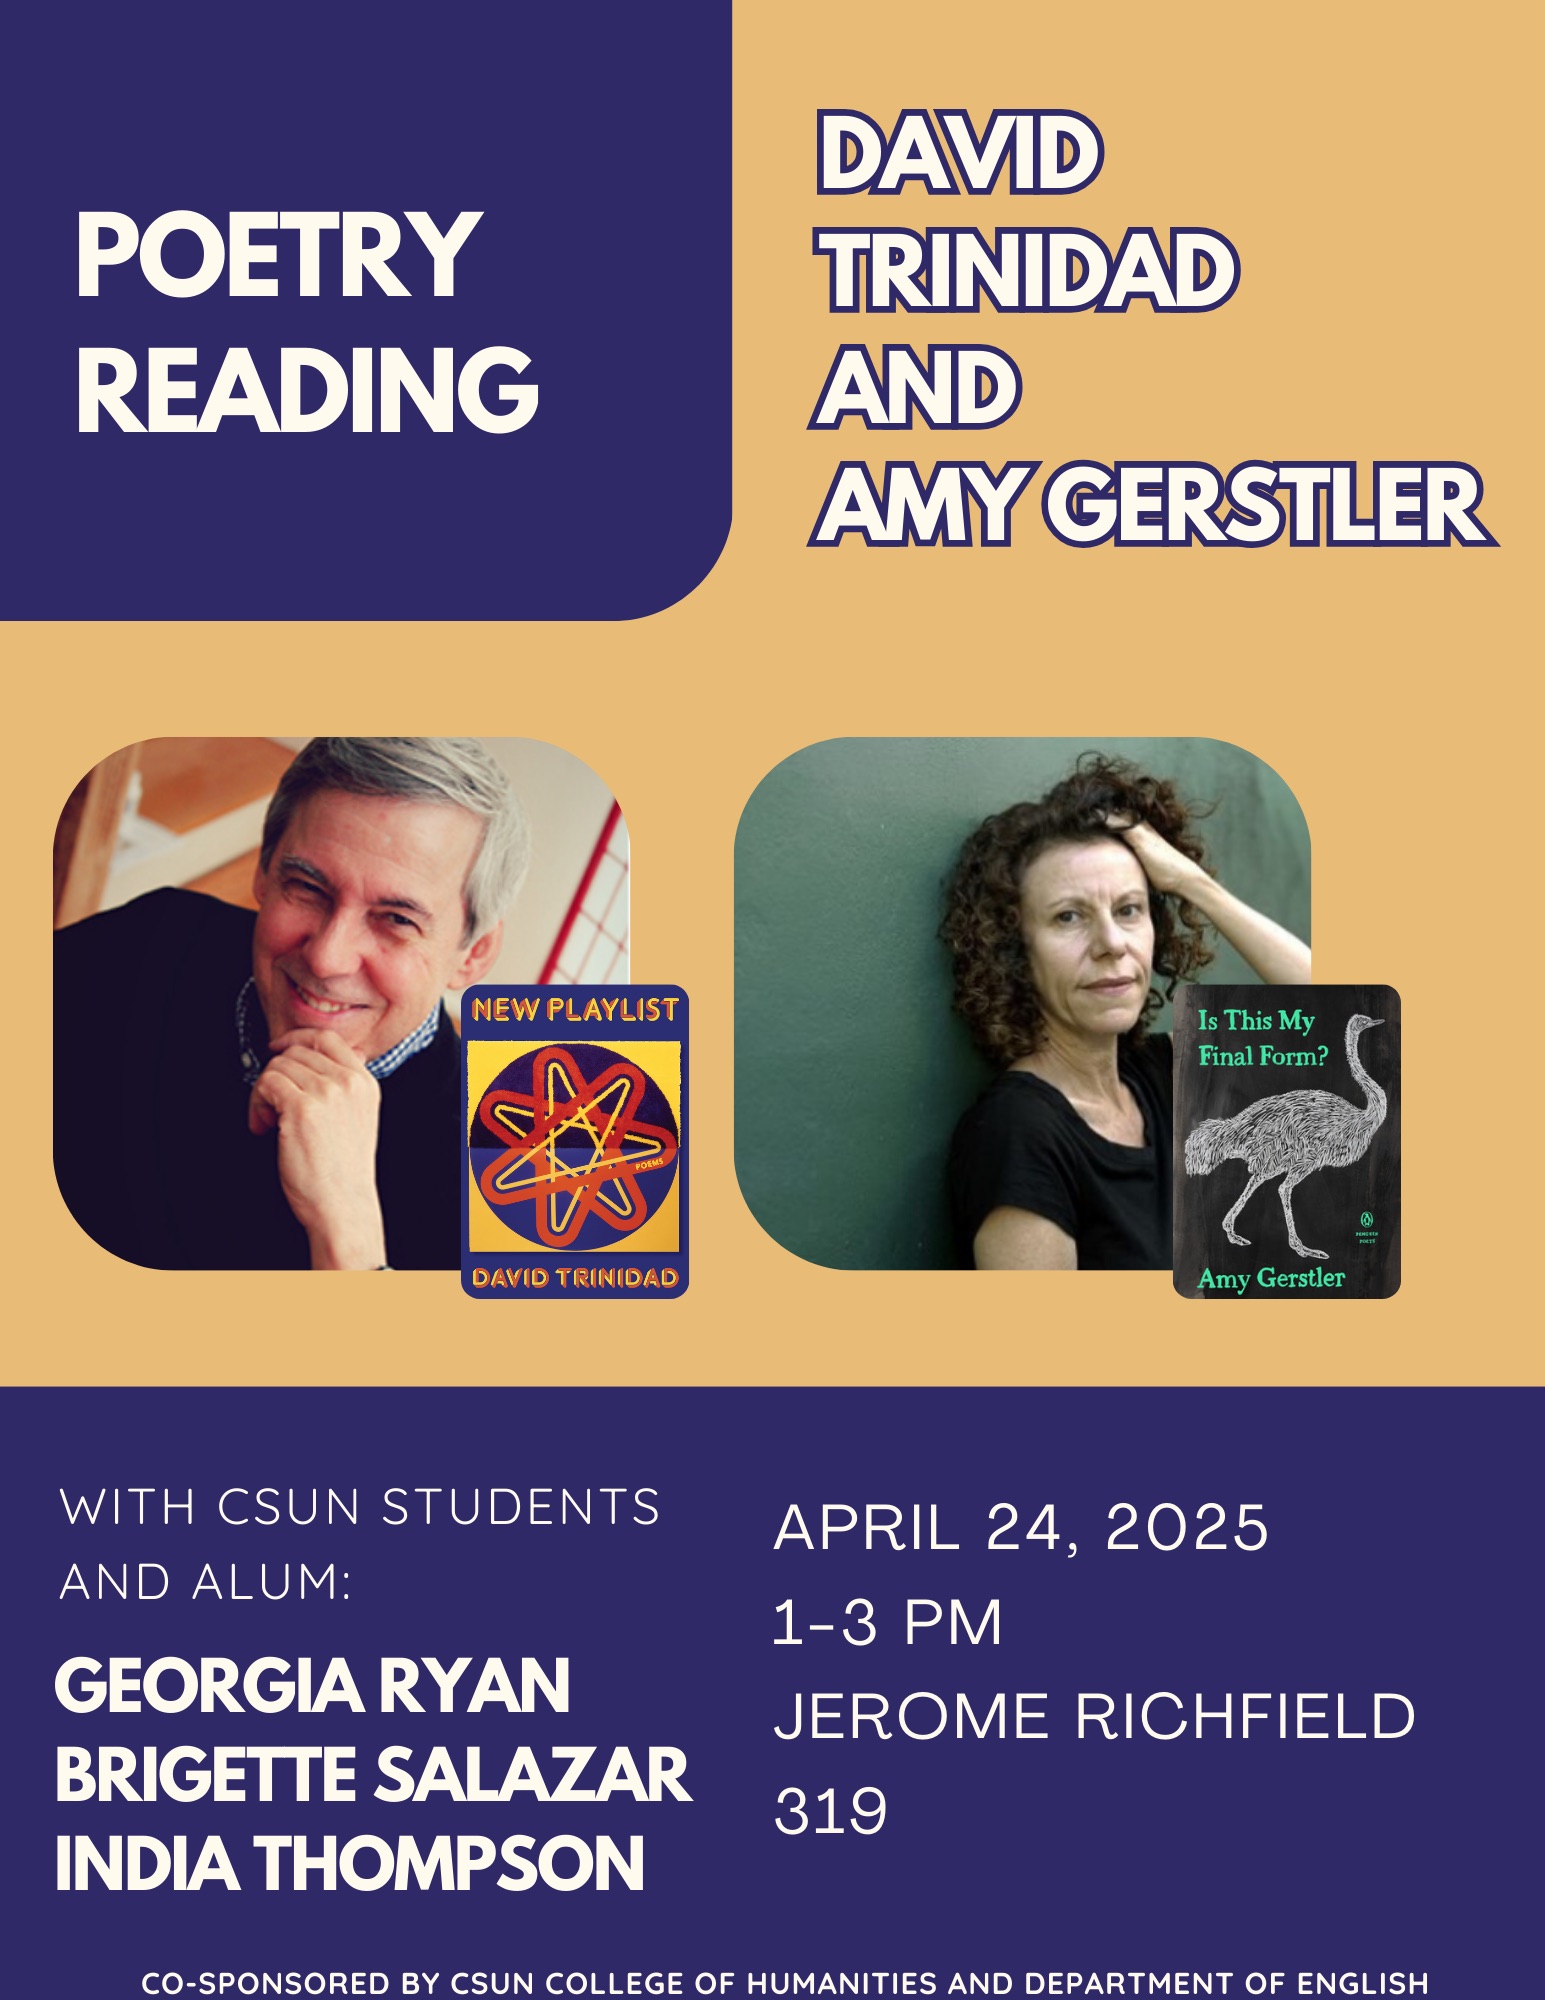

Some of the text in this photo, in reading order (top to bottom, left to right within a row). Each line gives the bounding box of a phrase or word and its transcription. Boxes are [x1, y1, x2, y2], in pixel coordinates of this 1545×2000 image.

[818, 110, 1104, 194] DAVID
[79, 210, 484, 297] POETRY
[813, 228, 1240, 312] TRINIDAD
[79, 346, 538, 433] READING
[808, 344, 1022, 429] AND
[808, 460, 1498, 547] AMY GERSTLER
[472, 998, 679, 1021] NEW PLAYLIST
[1198, 1009, 1315, 1036] Is This My
[1199, 1045, 1328, 1066] Final Form?
[635, 1157, 664, 1171] POEMS
[472, 1267, 680, 1288] DAVID TRINIDAD
[1197, 1267, 1345, 1295] Amy Gerstler
[60, 1488, 658, 1524] WITH CSUN STUDENTS
[774, 1503, 1267, 1558] APRIL 24, 2025
[60, 1564, 348, 1599] AND ALUM:
[908, 1600, 999, 1644] PM
[55, 1657, 568, 1713] GEORGIA RYAN
[774, 1692, 1414, 1740] JEROME RICHFIELD
[57, 1746, 693, 1802] BRIGETTE SALAZAR
[775, 1787, 886, 1835] 319
[57, 1835, 643, 1891] INDIA THOMPSON
[142, 1973, 1427, 1994] CO-SPONSORED BY CSUN COLLEGE OF HUMANITIES AND DEPARTMENT OF ENGLISH
